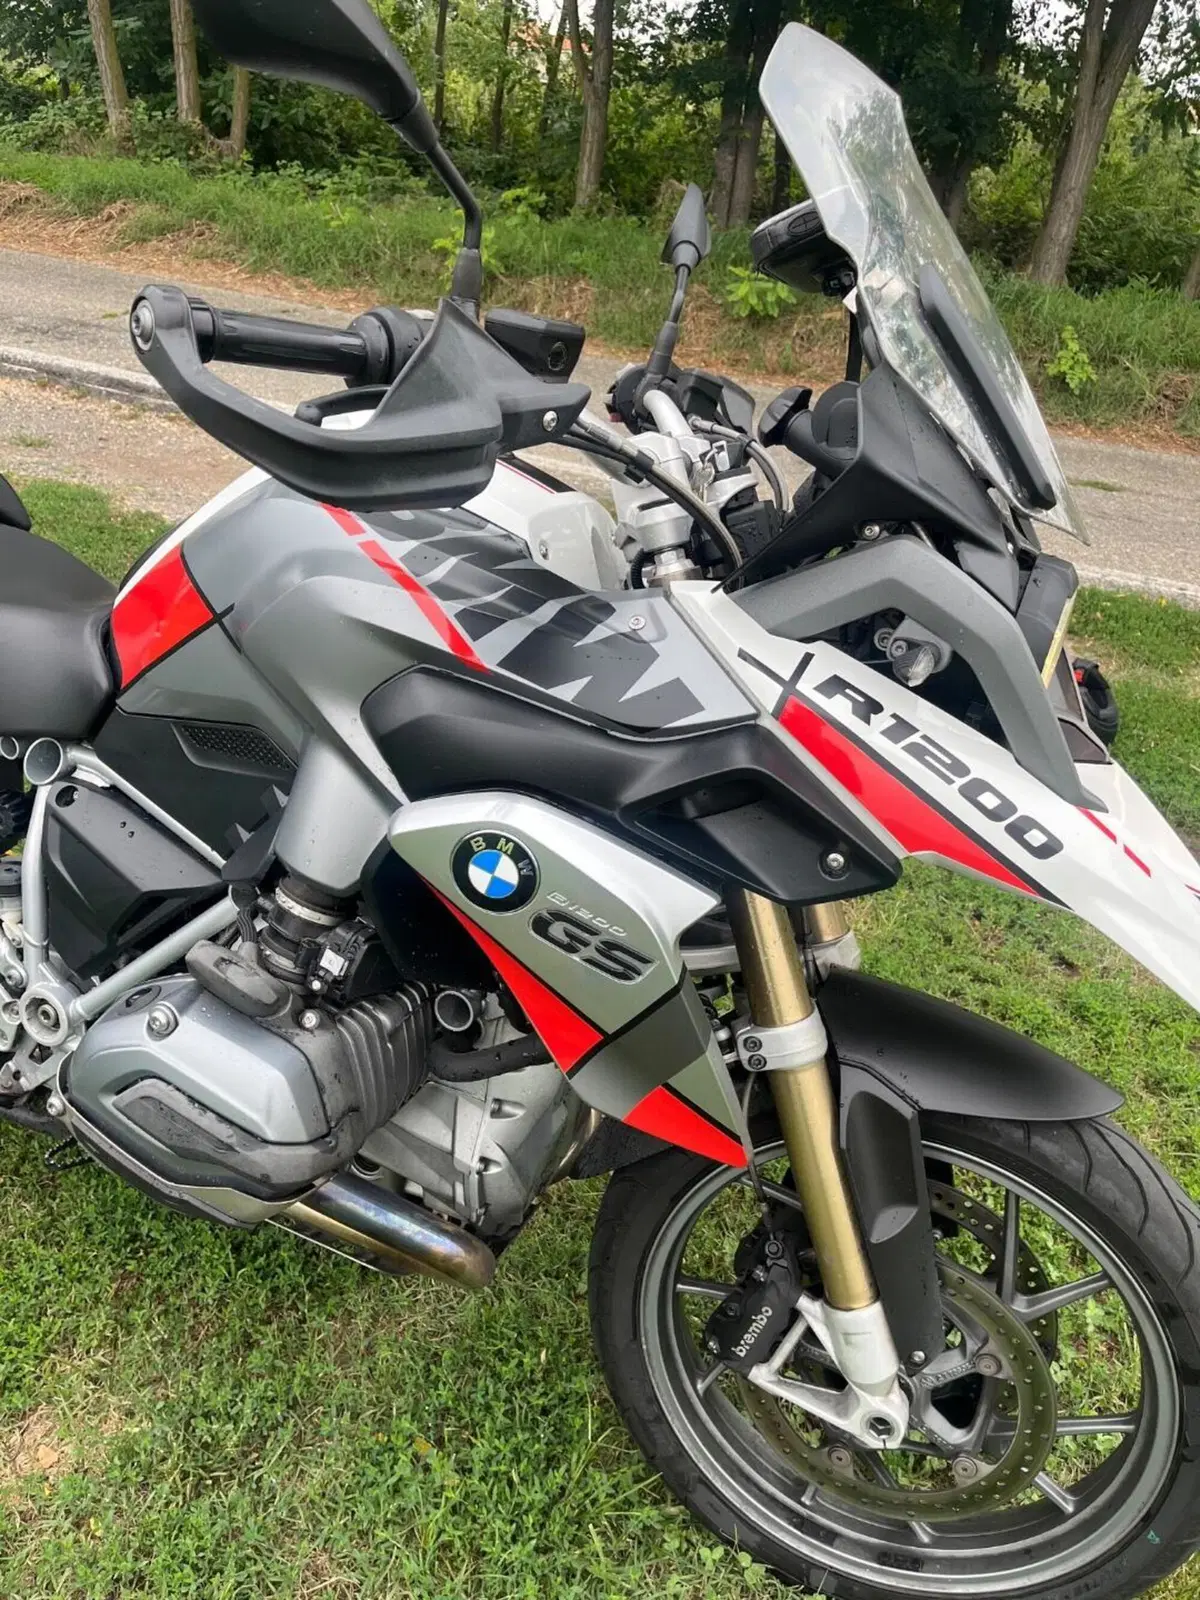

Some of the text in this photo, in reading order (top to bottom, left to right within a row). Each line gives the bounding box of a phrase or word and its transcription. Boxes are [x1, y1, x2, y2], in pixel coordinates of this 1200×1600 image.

[813, 674, 1064, 860] R1200
[470, 836, 534, 877] BMW
[530, 909, 660, 983] GS
[731, 1306, 773, 1357] brembo
